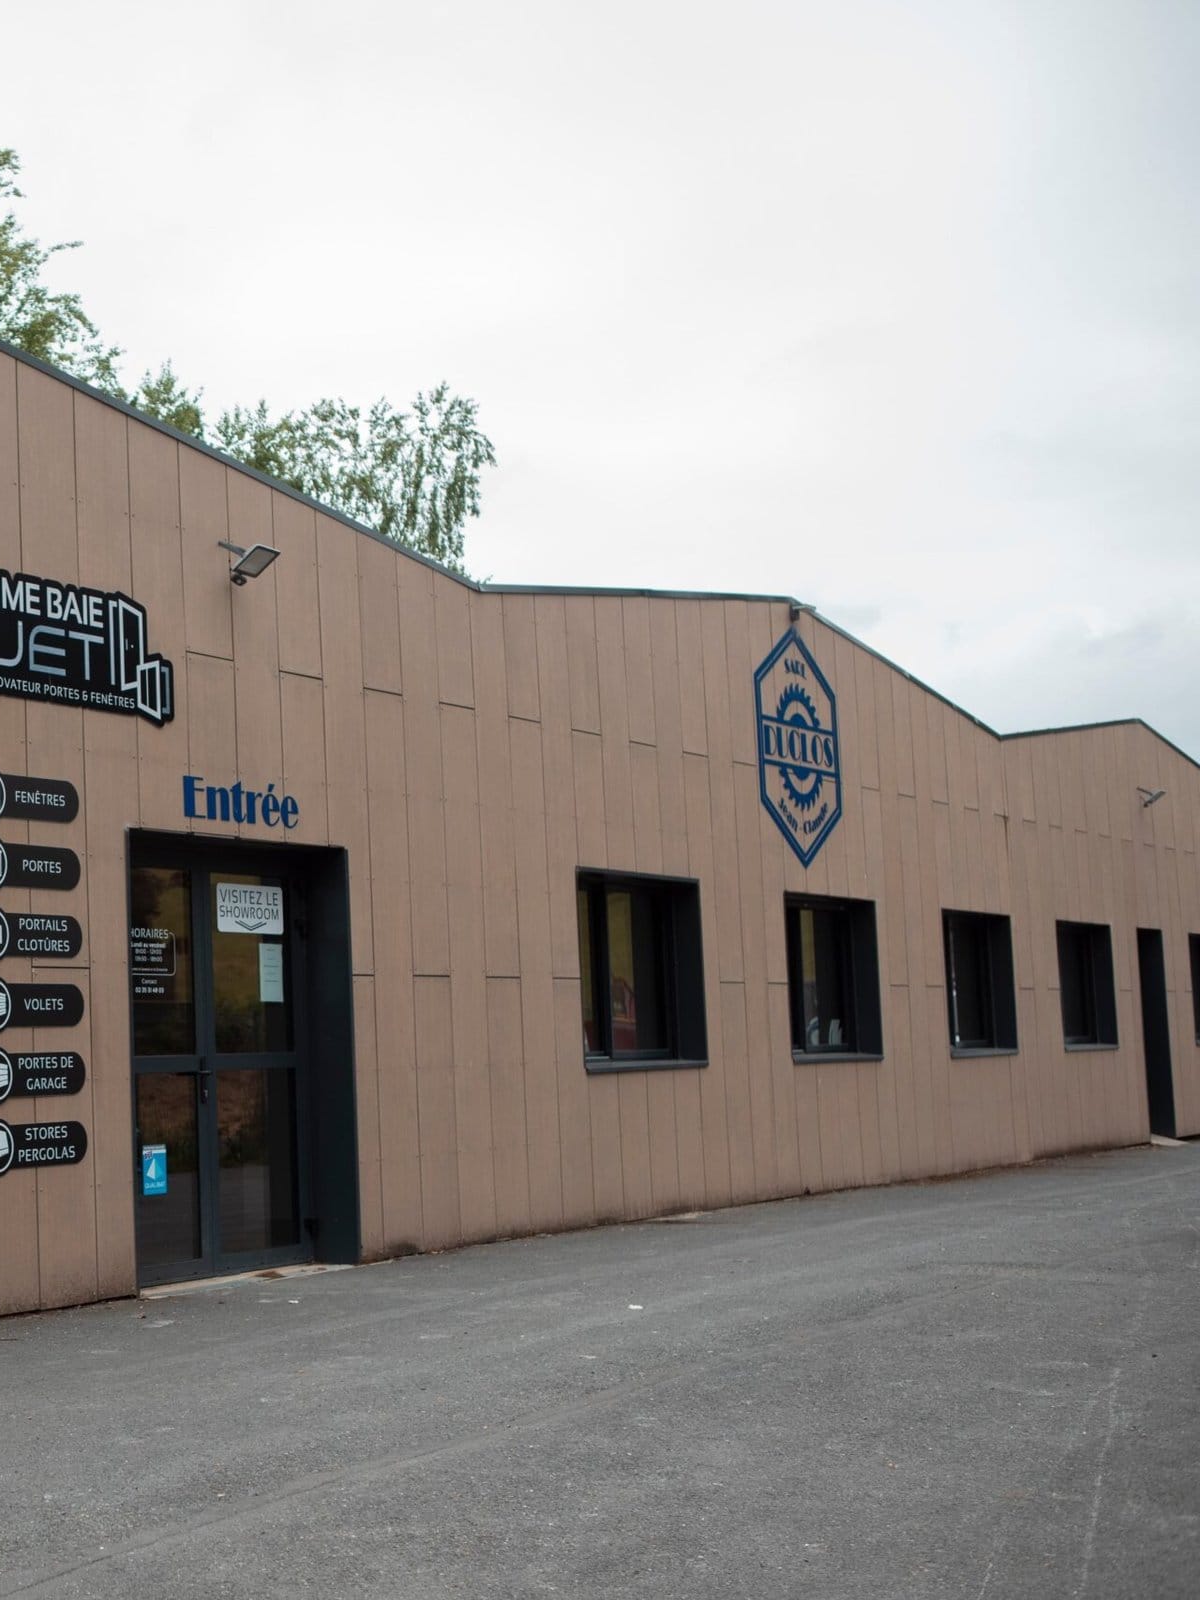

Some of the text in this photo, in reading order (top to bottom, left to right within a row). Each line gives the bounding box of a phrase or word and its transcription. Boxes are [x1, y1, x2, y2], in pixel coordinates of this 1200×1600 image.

[46, 586, 104, 629] BAIE
[43, 684, 80, 700] PORTES
[82, 691, 88, 702] &
[90, 690, 135, 709] FENÊTRES
[763, 724, 834, 769] DUCLOS
[14, 788, 66, 808] FENÊTRES
[182, 774, 300, 830] Entrée
[22, 859, 62, 875] PORTES
[219, 888, 279, 907] VISITEZ LE
[219, 904, 279, 920] SHOWROOM
[18, 917, 68, 933] PORTAILS
[23, 997, 65, 1012] VOLETS
[17, 1056, 75, 1071] PORTES DE
[26, 1076, 68, 1091] GARAGE
[25, 1125, 68, 1141] STORES
[18, 1145, 76, 1163] PERGOLAS
